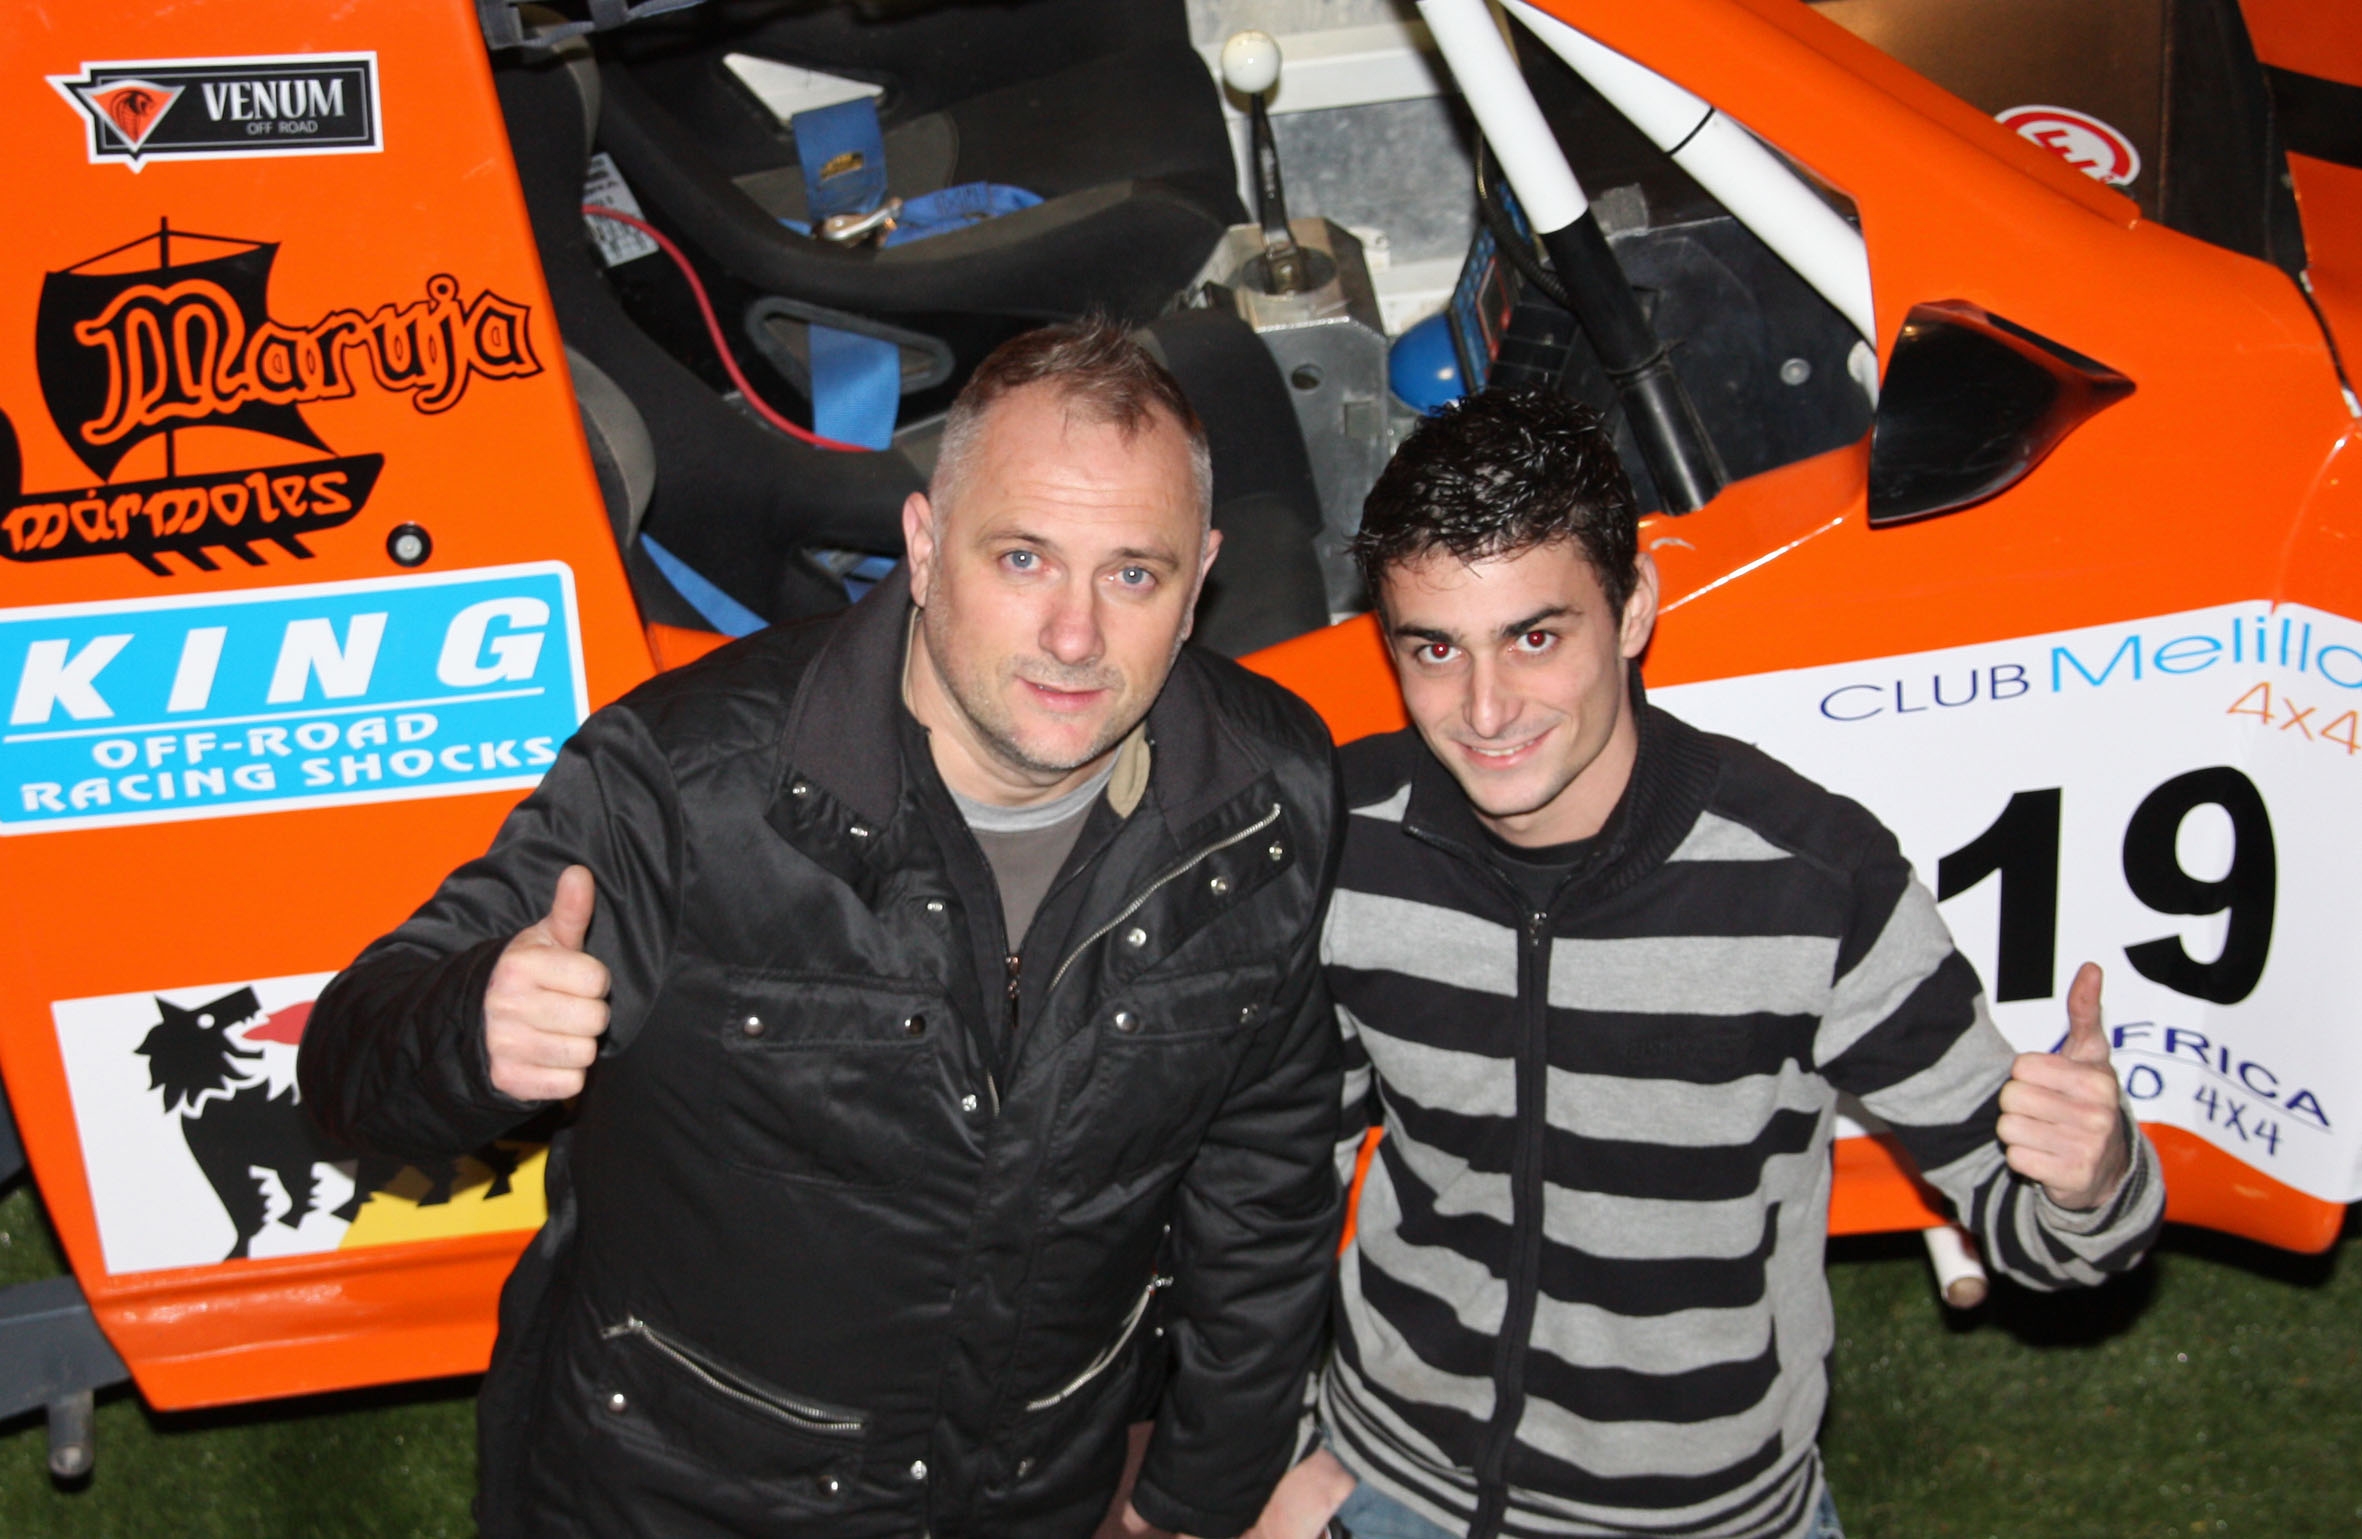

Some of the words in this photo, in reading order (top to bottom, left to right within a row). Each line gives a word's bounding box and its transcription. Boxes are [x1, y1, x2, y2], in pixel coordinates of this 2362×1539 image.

[202, 78, 345, 122] VENUM
[246, 121, 274, 135] OFF
[278, 120, 318, 133] ROAD
[74, 272, 545, 445] Maruja
[9, 597, 550, 725] KING
[1819, 664, 2030, 722] CLUB
[20, 763, 276, 814] RACING
[304, 736, 558, 788] SHOCKS
[92, 713, 438, 769] OFF-ROAD
[1938, 765, 2277, 1006] 19
[2050, 1021, 2330, 1127] FRICA
